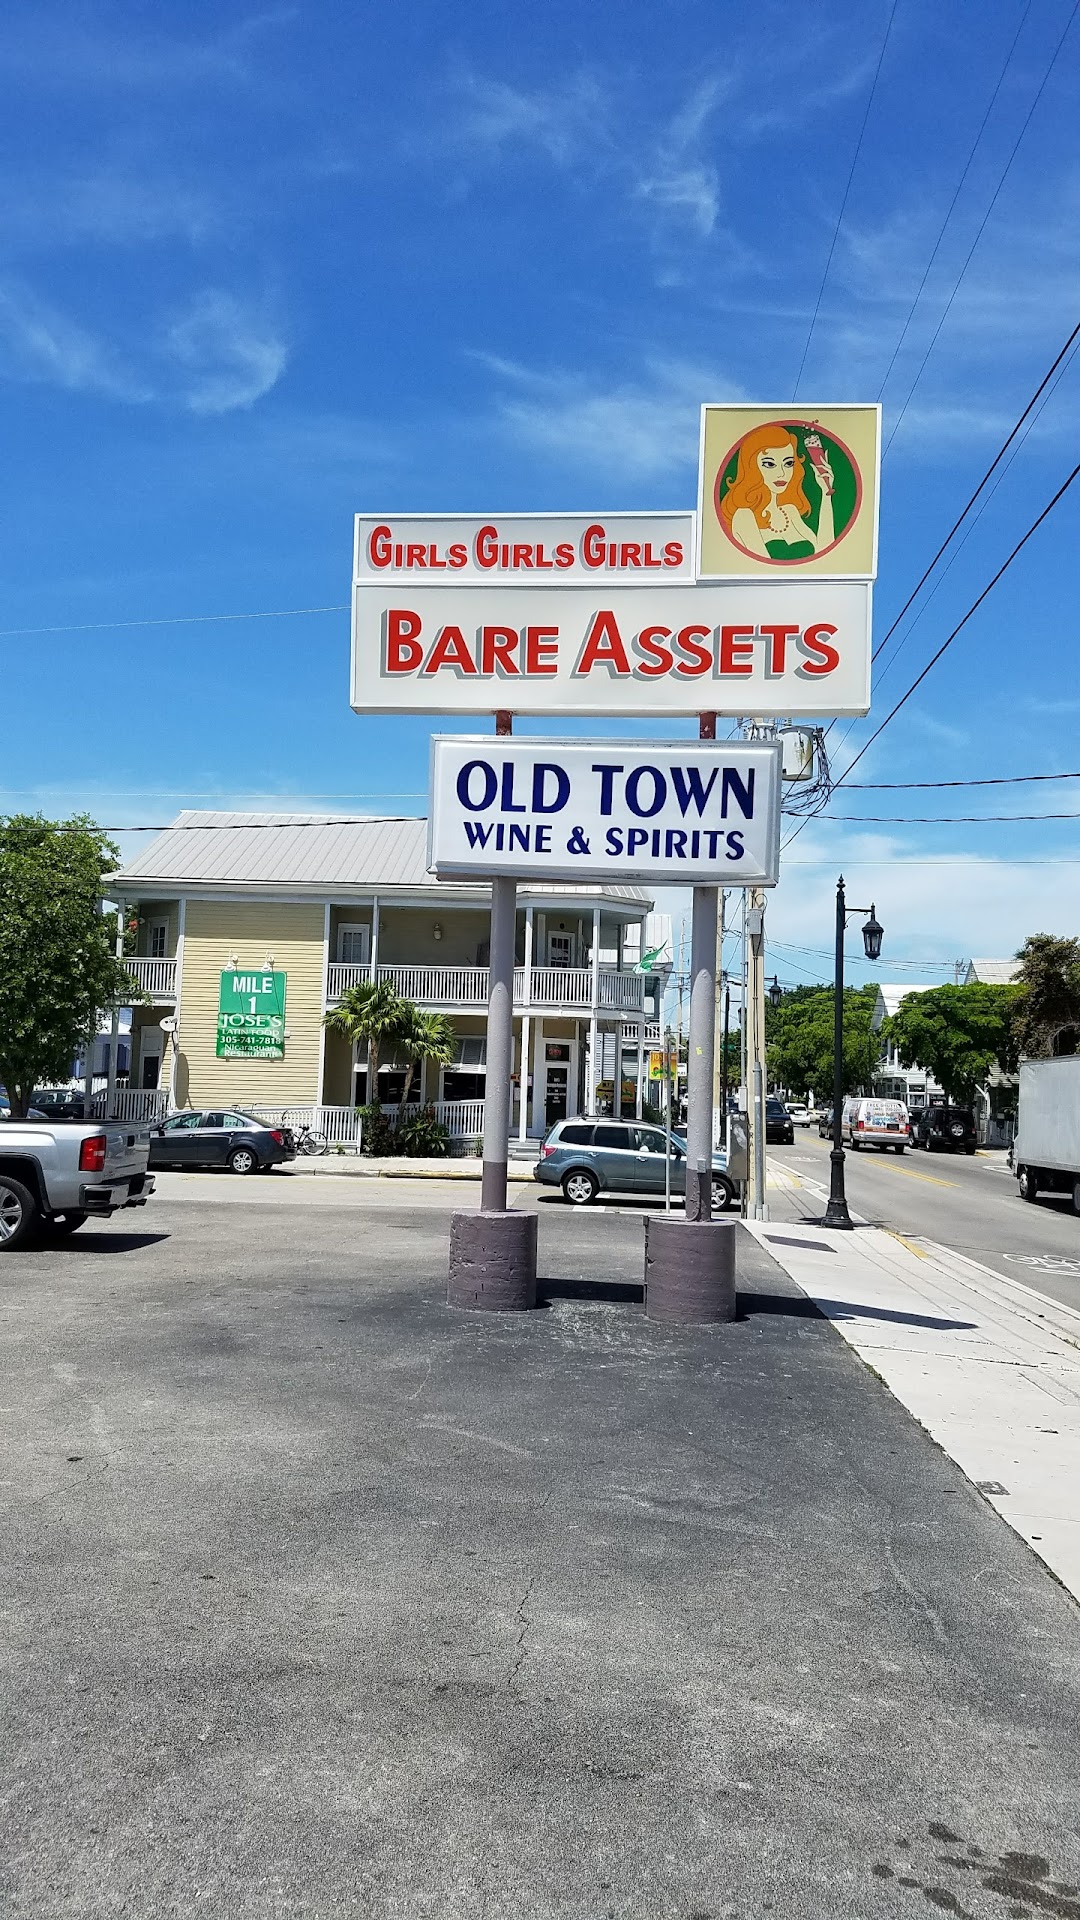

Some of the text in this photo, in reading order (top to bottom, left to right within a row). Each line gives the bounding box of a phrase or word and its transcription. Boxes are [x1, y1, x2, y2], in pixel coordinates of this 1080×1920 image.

[368, 524, 684, 569] GIRLS GIRLS GIRLS
[384, 609, 840, 677] BARE ASSETS
[456, 760, 756, 820] OLD TOWN
[463, 821, 745, 861] WINE & SPIRITS
[232, 976, 273, 994] MILE
[248, 996, 257, 1014] 1
[222, 1014, 281, 1028] JOSE'S
[220, 1036, 281, 1045] 305-741-7818
